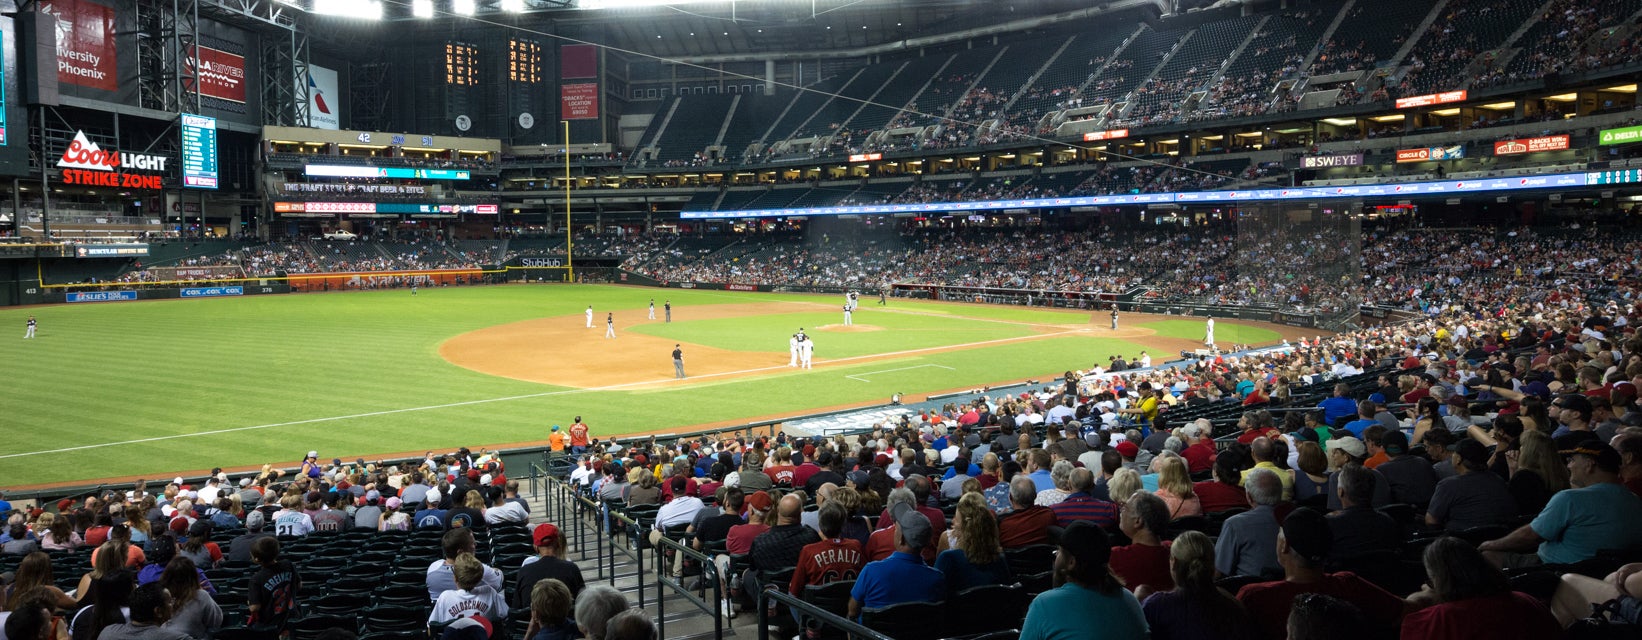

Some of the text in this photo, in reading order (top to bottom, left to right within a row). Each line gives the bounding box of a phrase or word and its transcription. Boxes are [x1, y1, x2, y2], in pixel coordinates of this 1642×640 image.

[58, 61, 103, 80] Phoenix
[185, 56, 244, 79] GLA RIVER
[201, 77, 235, 89] ASINOS
[358, 132, 371, 143] 42
[63, 140, 168, 171] Coors LIGHT
[63, 169, 163, 190] STRIKE ZONE
[521, 258, 561, 267] StubHub
[25, 287, 37, 295] 413
[278, 524, 294, 536] 21
[448, 600, 490, 618] GOLDSCHMIDT
